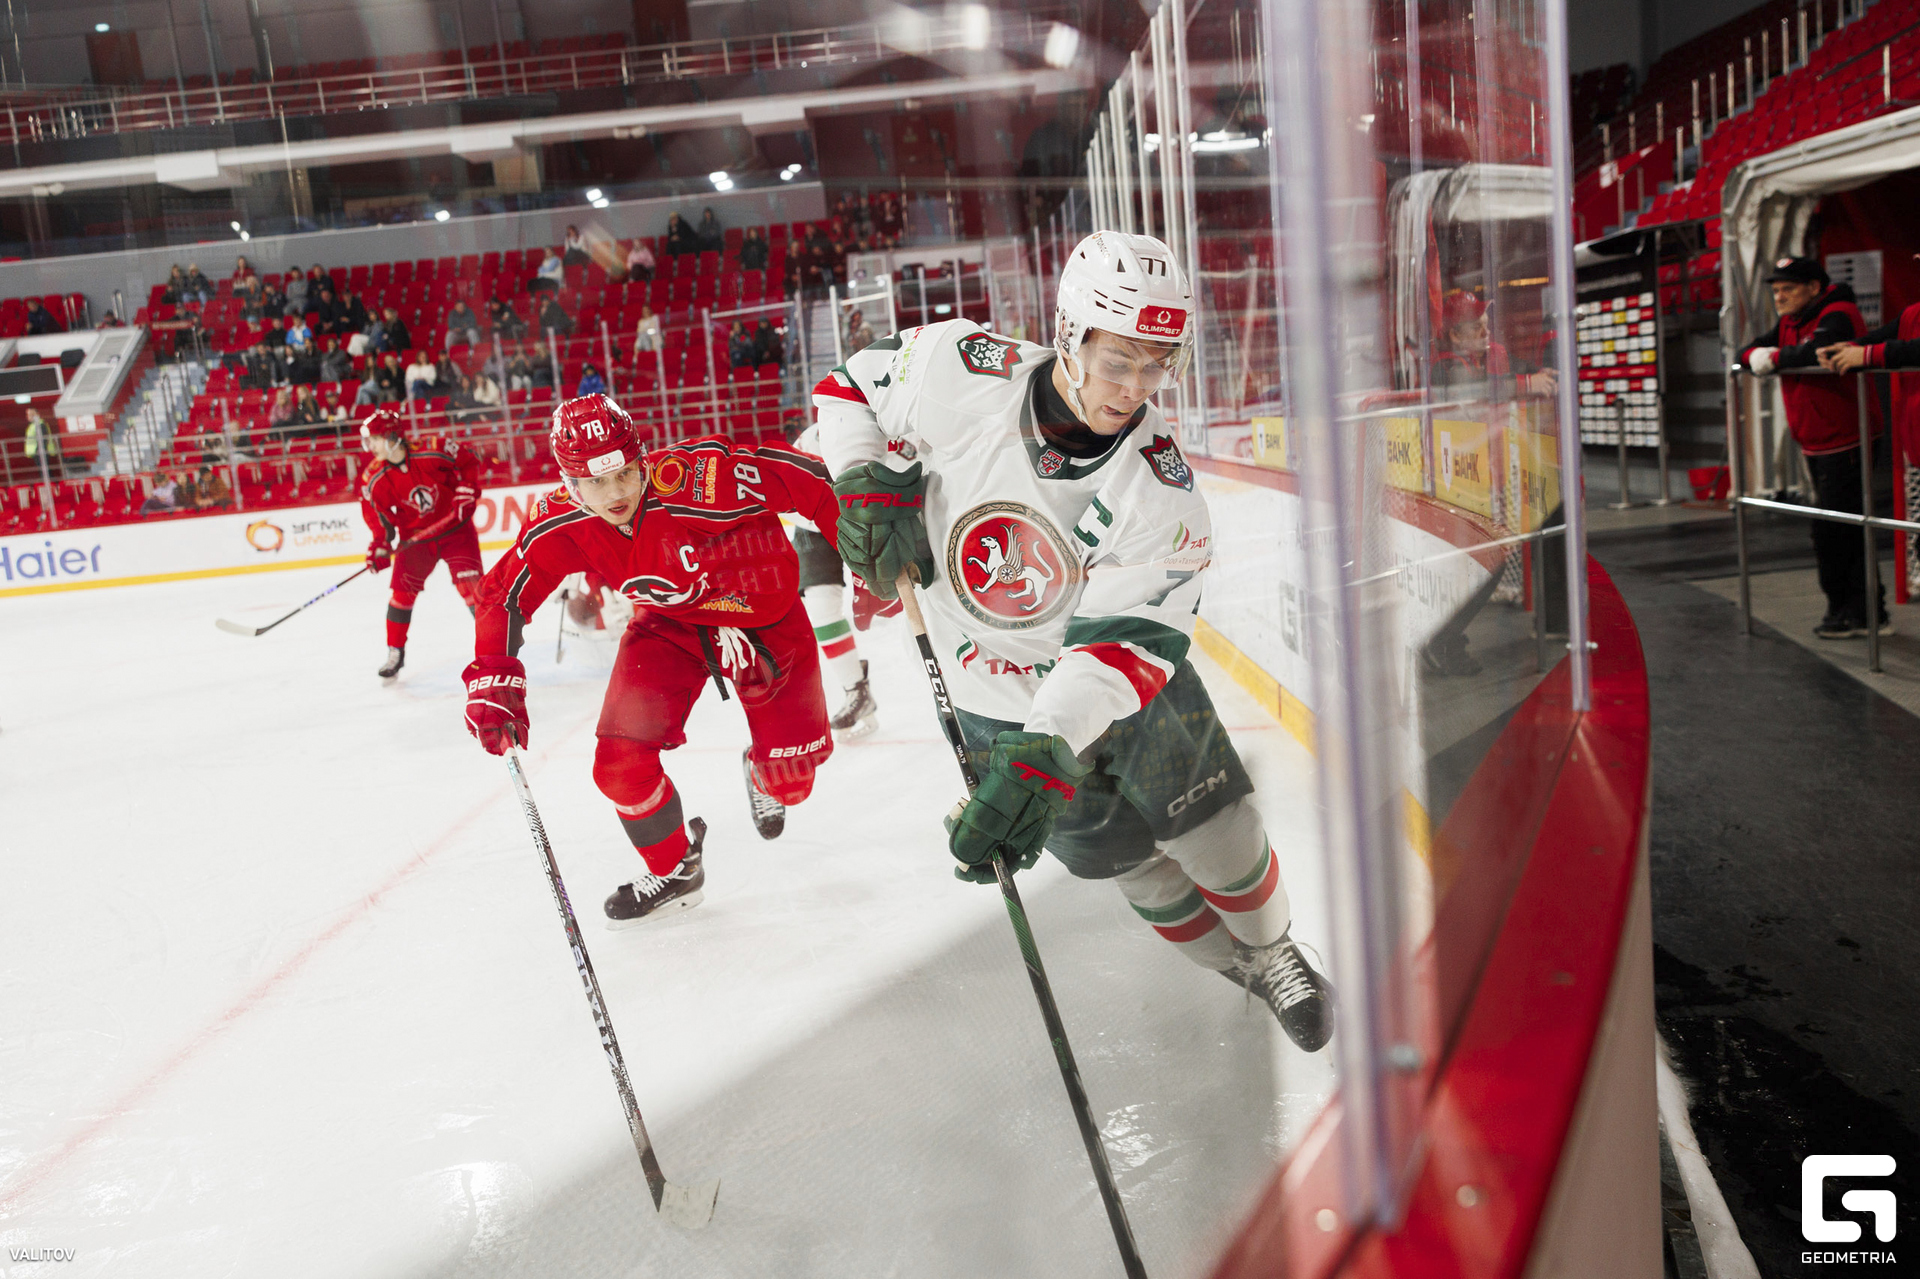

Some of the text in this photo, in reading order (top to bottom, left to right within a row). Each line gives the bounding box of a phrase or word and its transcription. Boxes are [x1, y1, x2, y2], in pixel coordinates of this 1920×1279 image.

[1140, 257, 1166, 277] 77
[1139, 324, 1181, 335] OLIMPBET
[580, 419, 605, 440] 78
[1387, 440, 1412, 466] БАНК
[1454, 450, 1480, 483] БАНК
[705, 456, 718, 504] UMMC
[733, 462, 767, 503] 78
[472, 493, 538, 534] ON
[0, 541, 101, 581] Haier
[679, 545, 700, 573] C
[925, 658, 952, 713] CCM
[769, 735, 826, 758] BAUER
[1167, 769, 1228, 817] CCM
